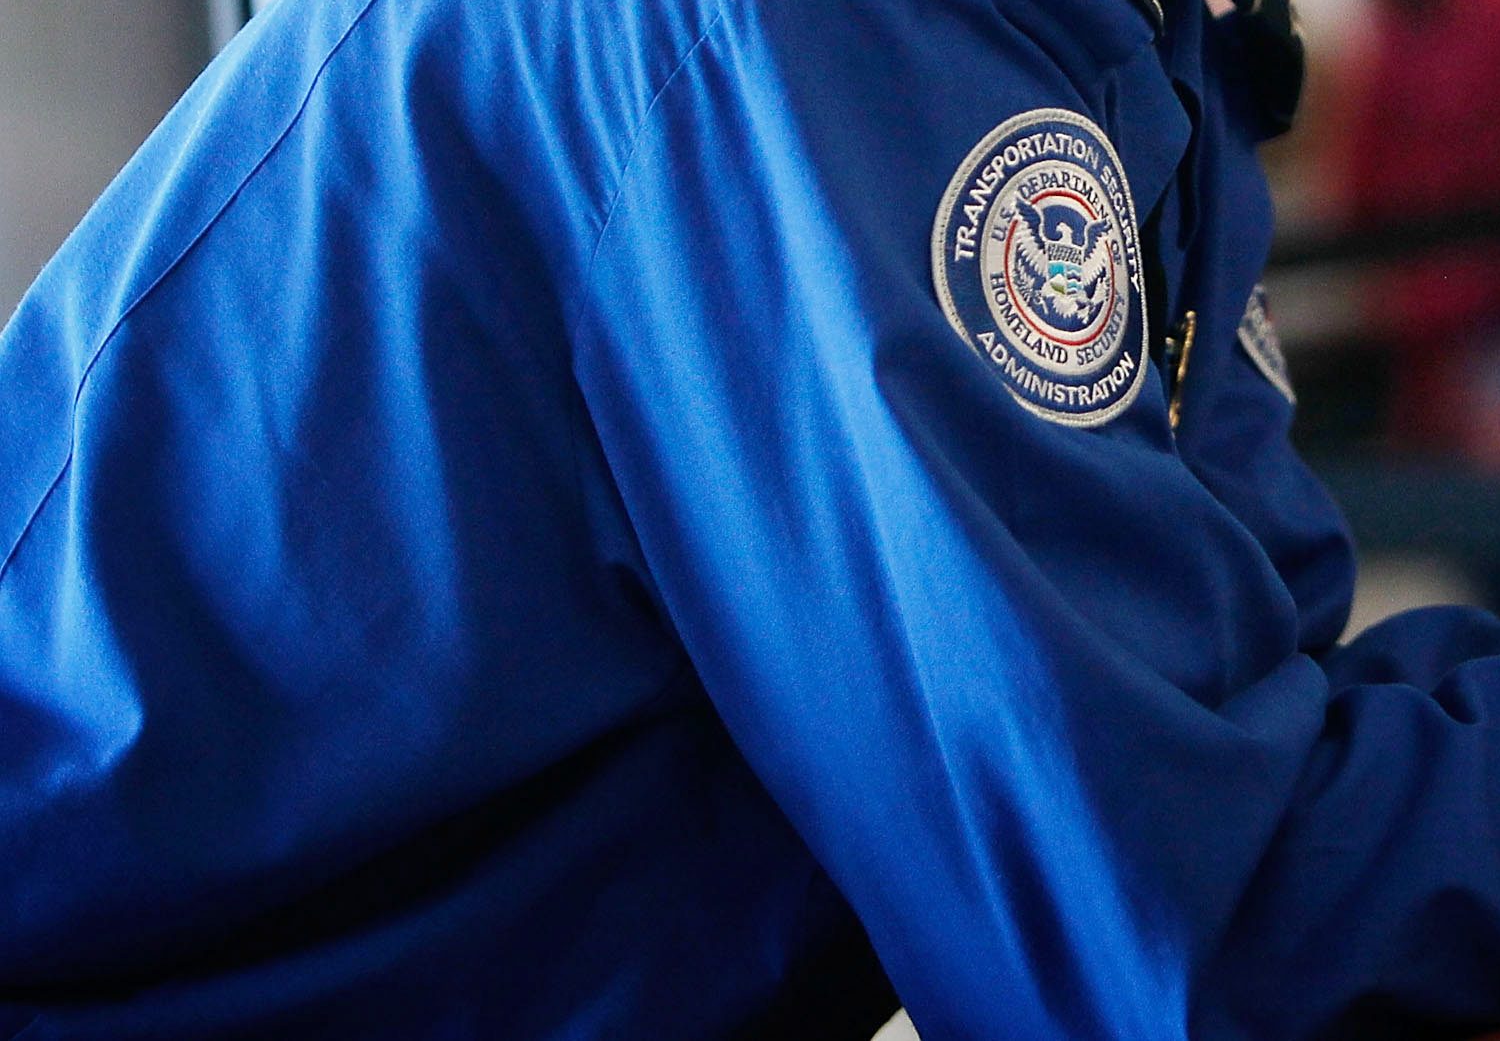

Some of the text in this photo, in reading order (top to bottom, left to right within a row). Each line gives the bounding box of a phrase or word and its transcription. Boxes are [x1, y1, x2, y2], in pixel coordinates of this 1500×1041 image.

[955, 132, 1142, 294] TRANSPORTATION SECURITY
[1110, 239, 1122, 266] OF
[989, 270, 1126, 366] HOMELAND SECURITY
[976, 329, 1135, 407] ADMINISTRATION
